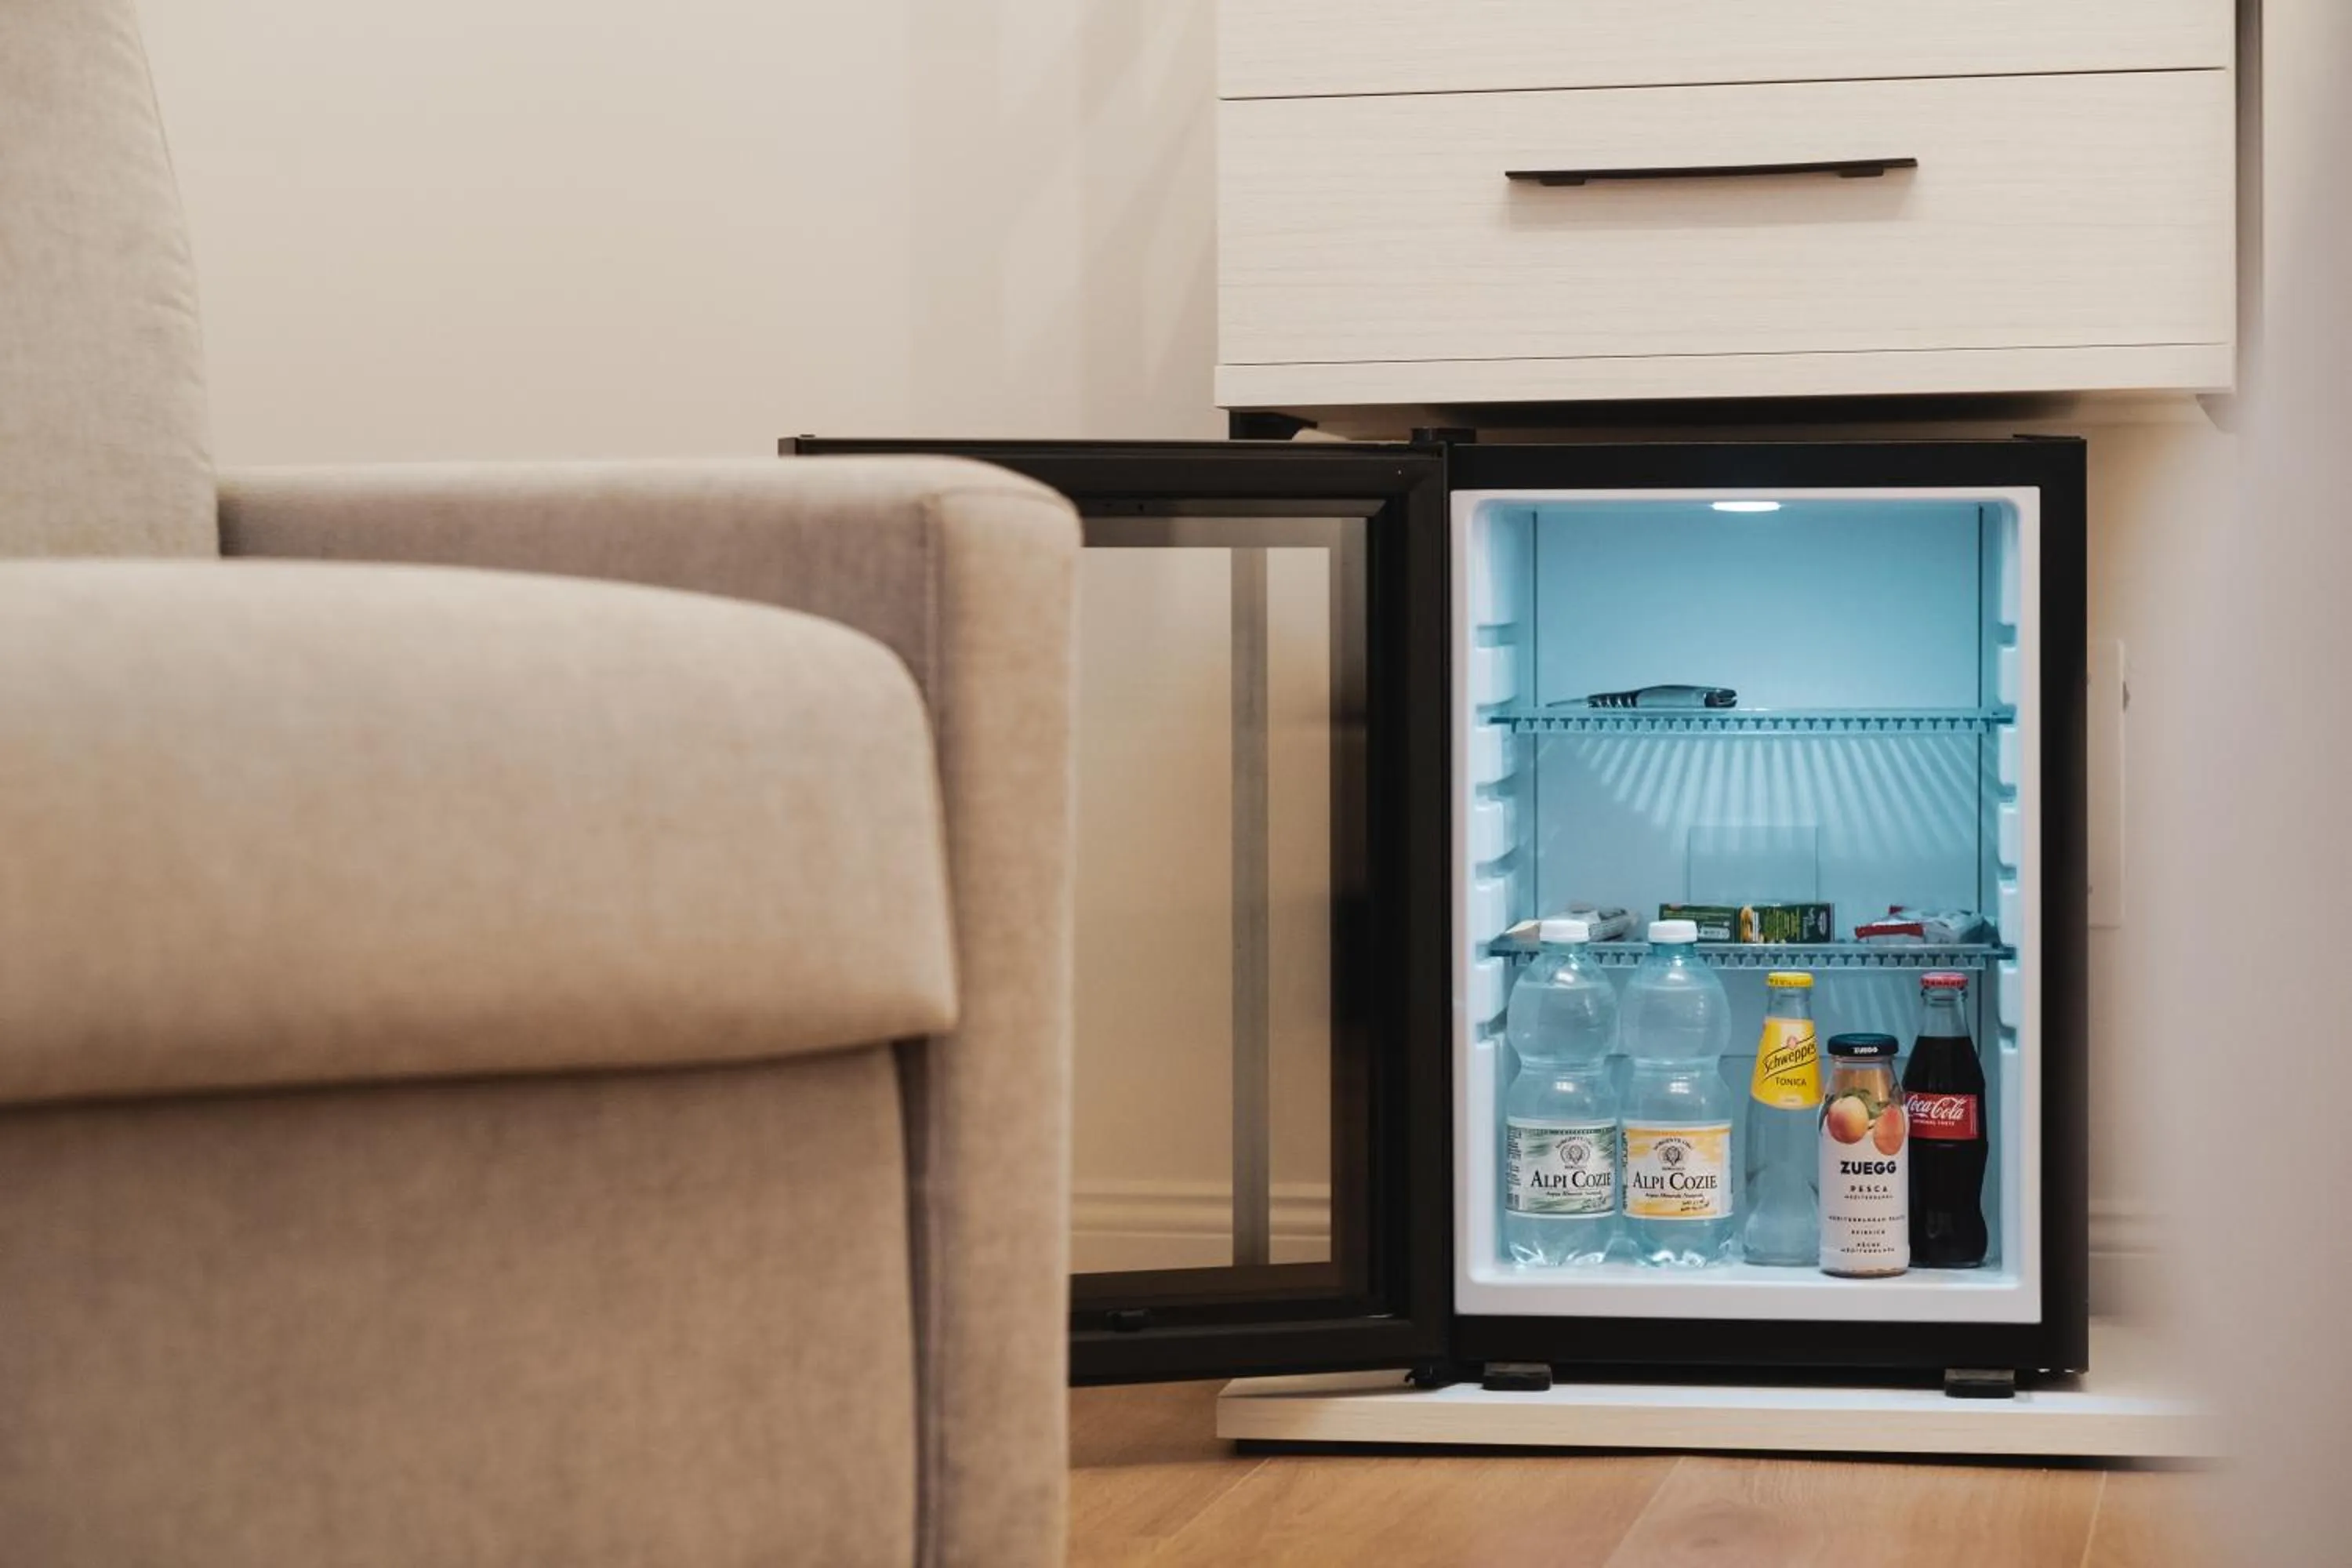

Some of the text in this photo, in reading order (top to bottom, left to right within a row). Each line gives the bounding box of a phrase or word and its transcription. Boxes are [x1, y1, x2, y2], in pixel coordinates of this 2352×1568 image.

[1764, 1044, 1817, 1073] Schweppes
[1775, 1077, 1807, 1087] TONICA
[1906, 1094, 1967, 1120] Coca-Cola
[1840, 1160, 1896, 1174] ZUEGG
[1530, 1169, 1611, 1188] ALPI COZIE
[1633, 1171, 1718, 1190] ALPI COZIE
